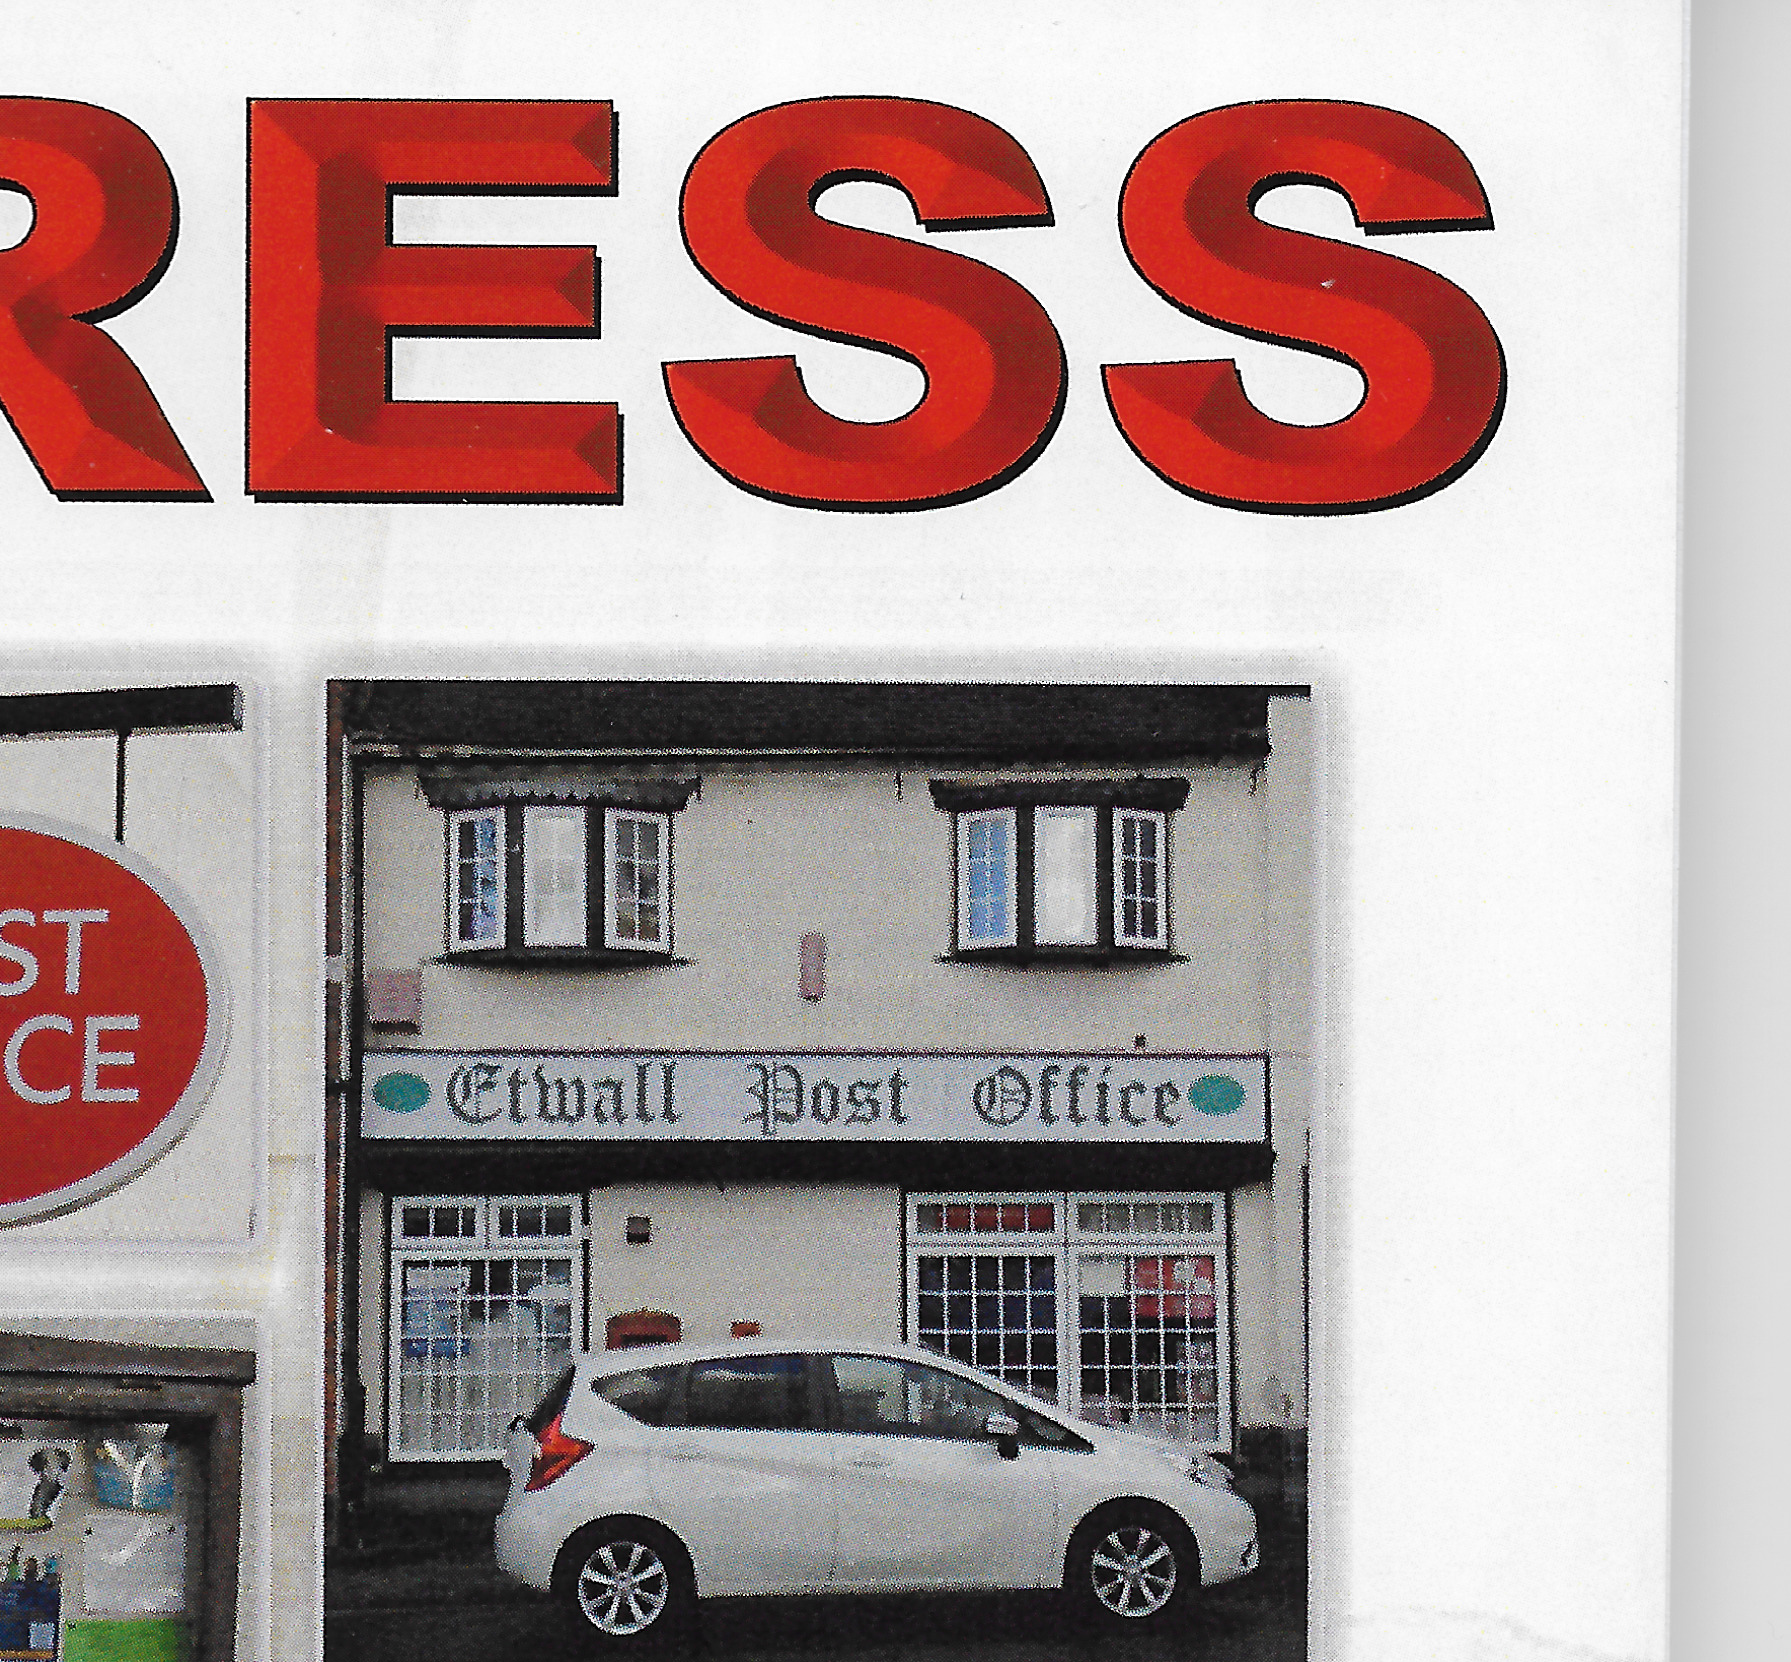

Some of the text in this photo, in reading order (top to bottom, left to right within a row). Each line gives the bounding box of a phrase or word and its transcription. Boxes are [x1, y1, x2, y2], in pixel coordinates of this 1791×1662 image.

[446, 1061, 1184, 1136] Etwall Post Office
